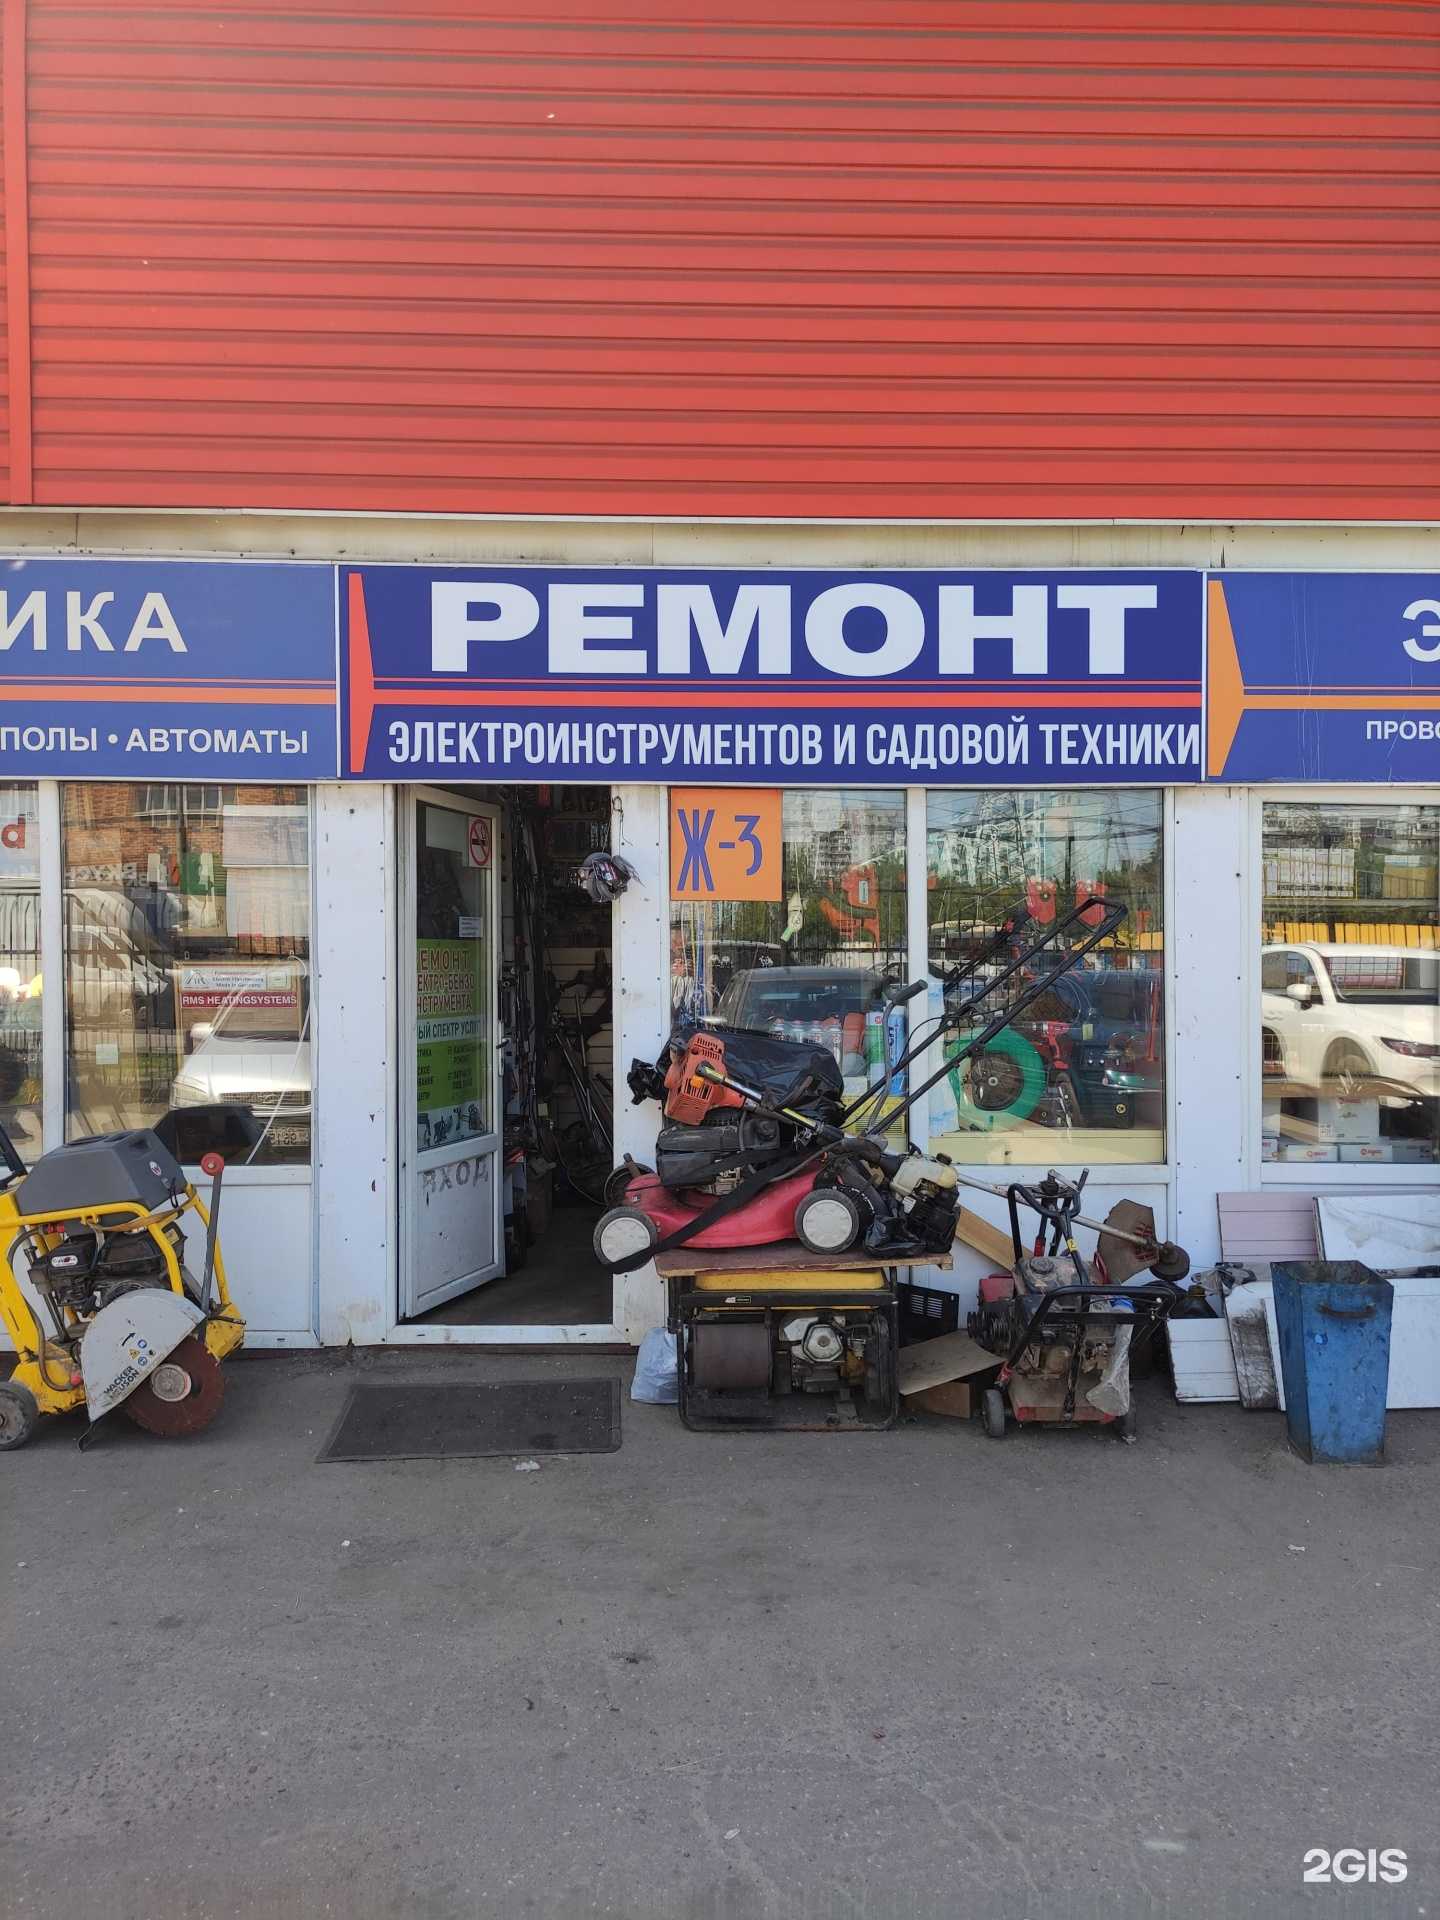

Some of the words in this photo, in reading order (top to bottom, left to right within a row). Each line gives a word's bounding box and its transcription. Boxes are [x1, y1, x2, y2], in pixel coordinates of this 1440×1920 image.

[0, 591, 188, 652] ИКА
[432, 582, 1157, 677] РЕМОНТ
[1403, 599, 1440, 662] Э
[1, 727, 96, 750] ПОЛЫ
[125, 728, 308, 753] АВТОМАТЫ
[388, 720, 822, 766] ЭЛЕКТРОИНСТРУМЕНТОВ
[833, 724, 856, 765] И
[866, 715, 1029, 770] САДОВОЙ
[1039, 723, 1200, 766] ТЕХНИКИ
[677, 809, 763, 891] Ж-3
[417, 950, 470, 971] ЕМОНТ
[182, 996, 205, 1005] RMS
[417, 1022, 431, 1040] ЫЙ
[432, 1021, 459, 1038] СПЕКТР
[104, 1366, 135, 1394] WACKER
